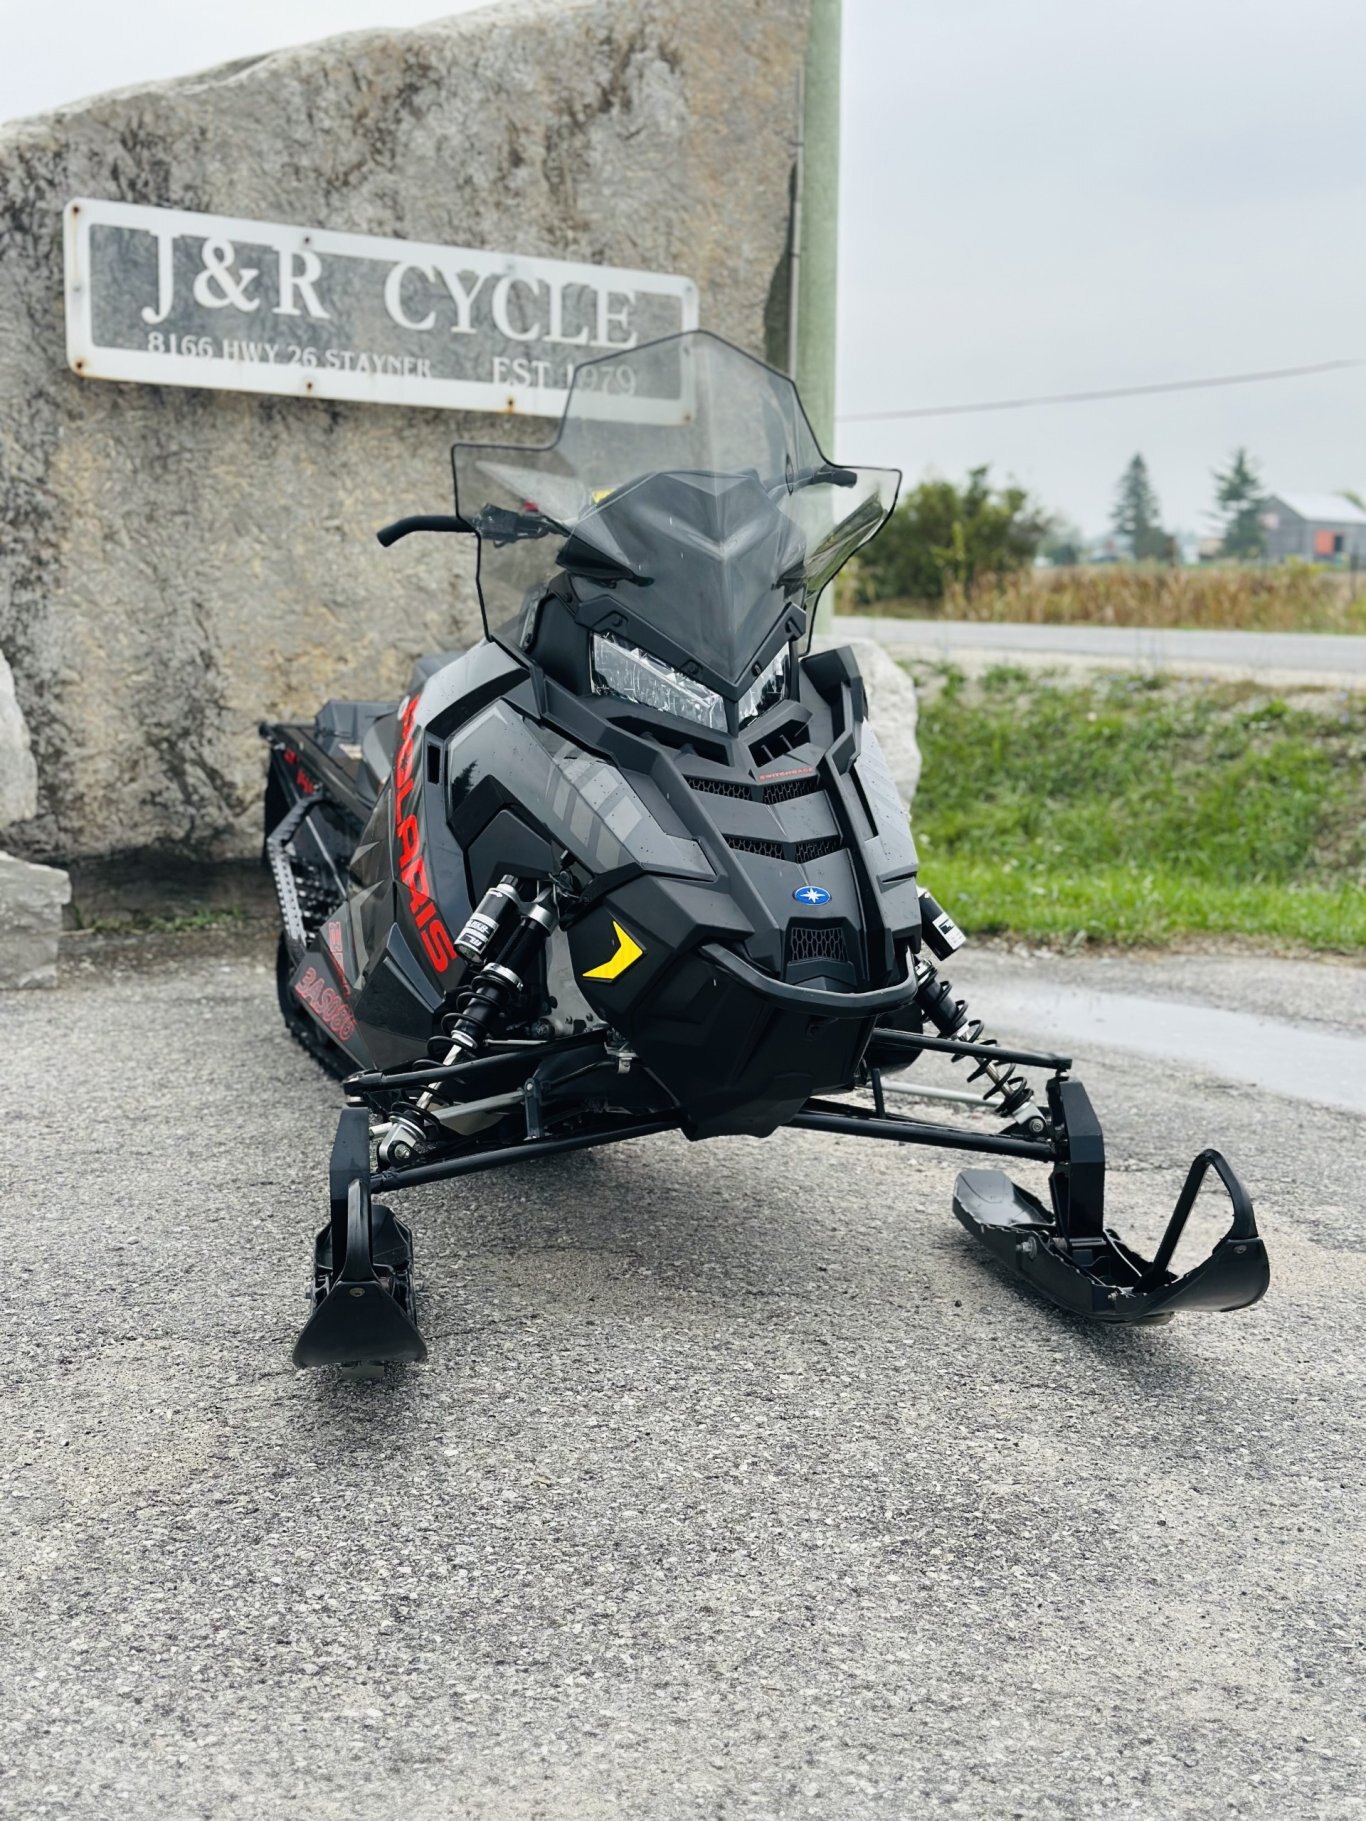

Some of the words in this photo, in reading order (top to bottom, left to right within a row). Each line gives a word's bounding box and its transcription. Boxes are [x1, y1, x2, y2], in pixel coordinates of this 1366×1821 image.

[140, 230, 331, 324] J&R
[384, 262, 638, 349] CYCLE
[147, 331, 213, 359] 8166
[222, 338, 279, 364] HWY
[286, 344, 318, 370] 26
[324, 348, 432, 379] STAYNER
[493, 356, 550, 389] EST
[566, 362, 637, 398] 1979
[395, 694, 458, 974] POLARIS
